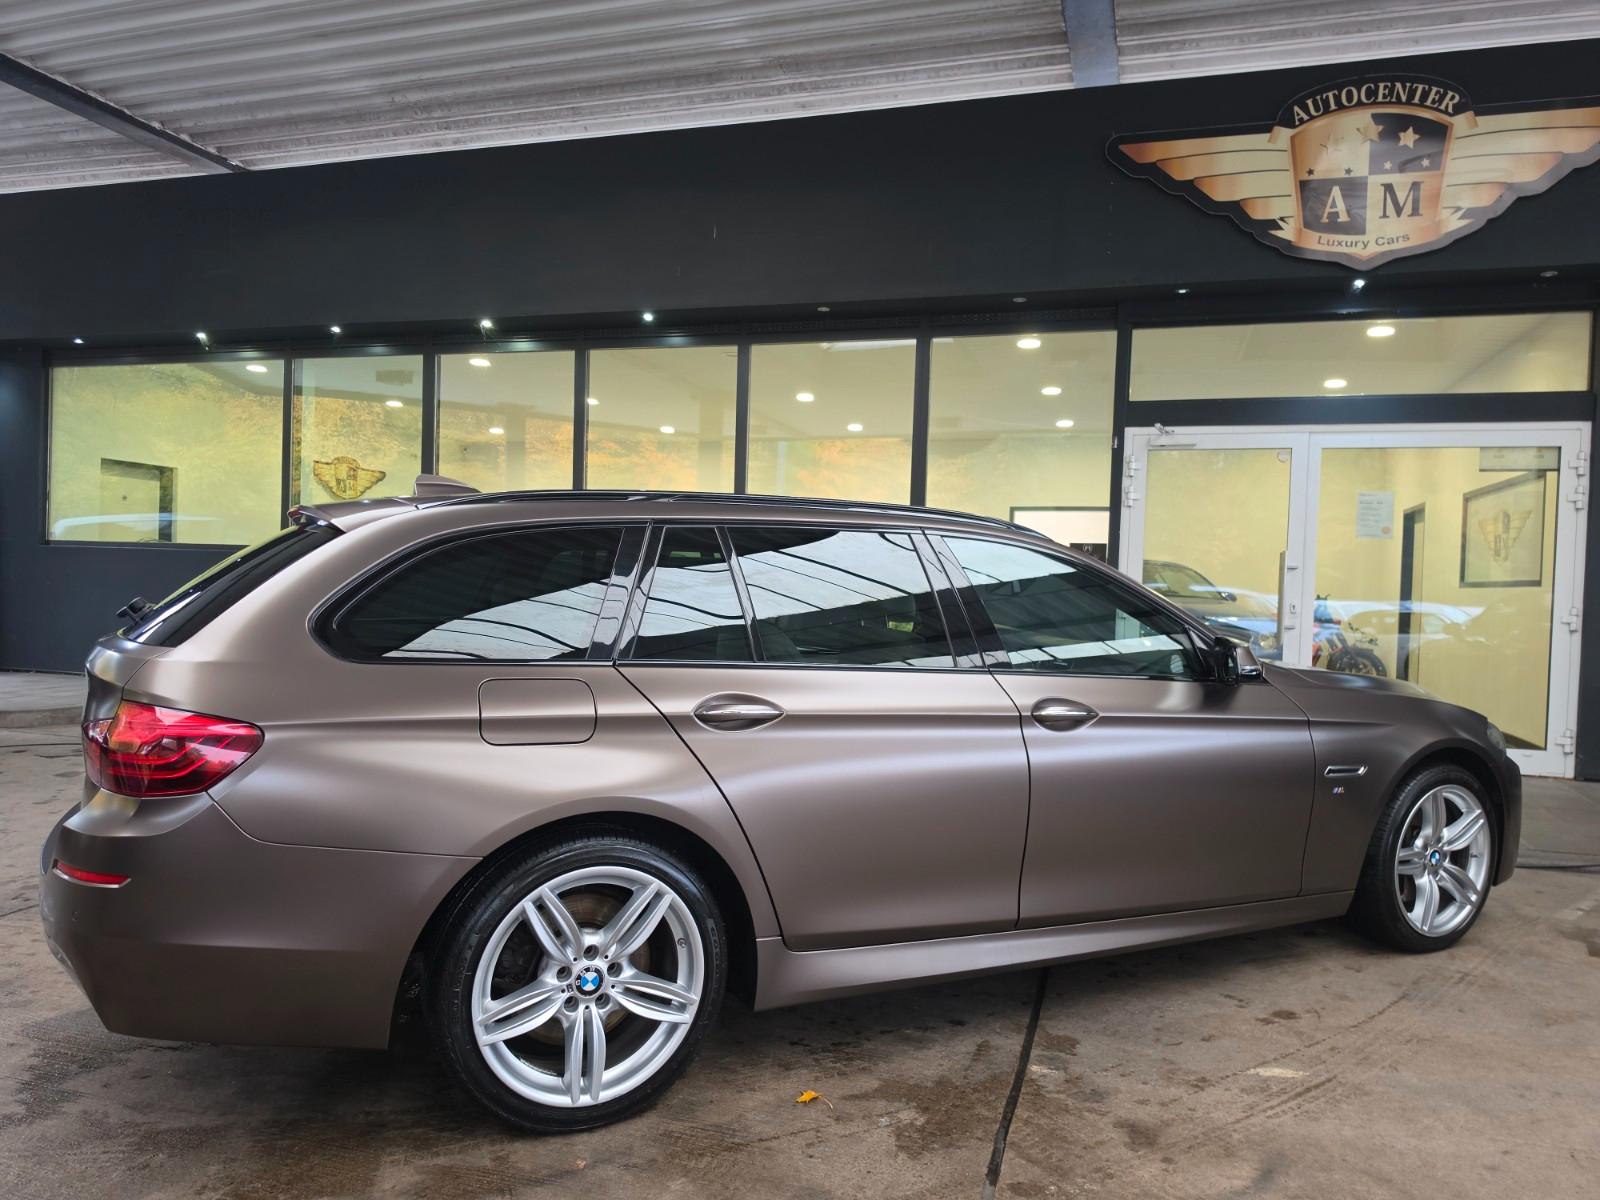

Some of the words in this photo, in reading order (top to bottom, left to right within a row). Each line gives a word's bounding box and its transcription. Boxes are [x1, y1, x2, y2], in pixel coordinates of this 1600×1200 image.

[1293, 82, 1460, 125] AUTOCENTER
[1320, 185, 1351, 223] A
[1379, 181, 1424, 219] M
[1317, 235, 1370, 249] Luxury
[1375, 234, 1410, 247] Cars
